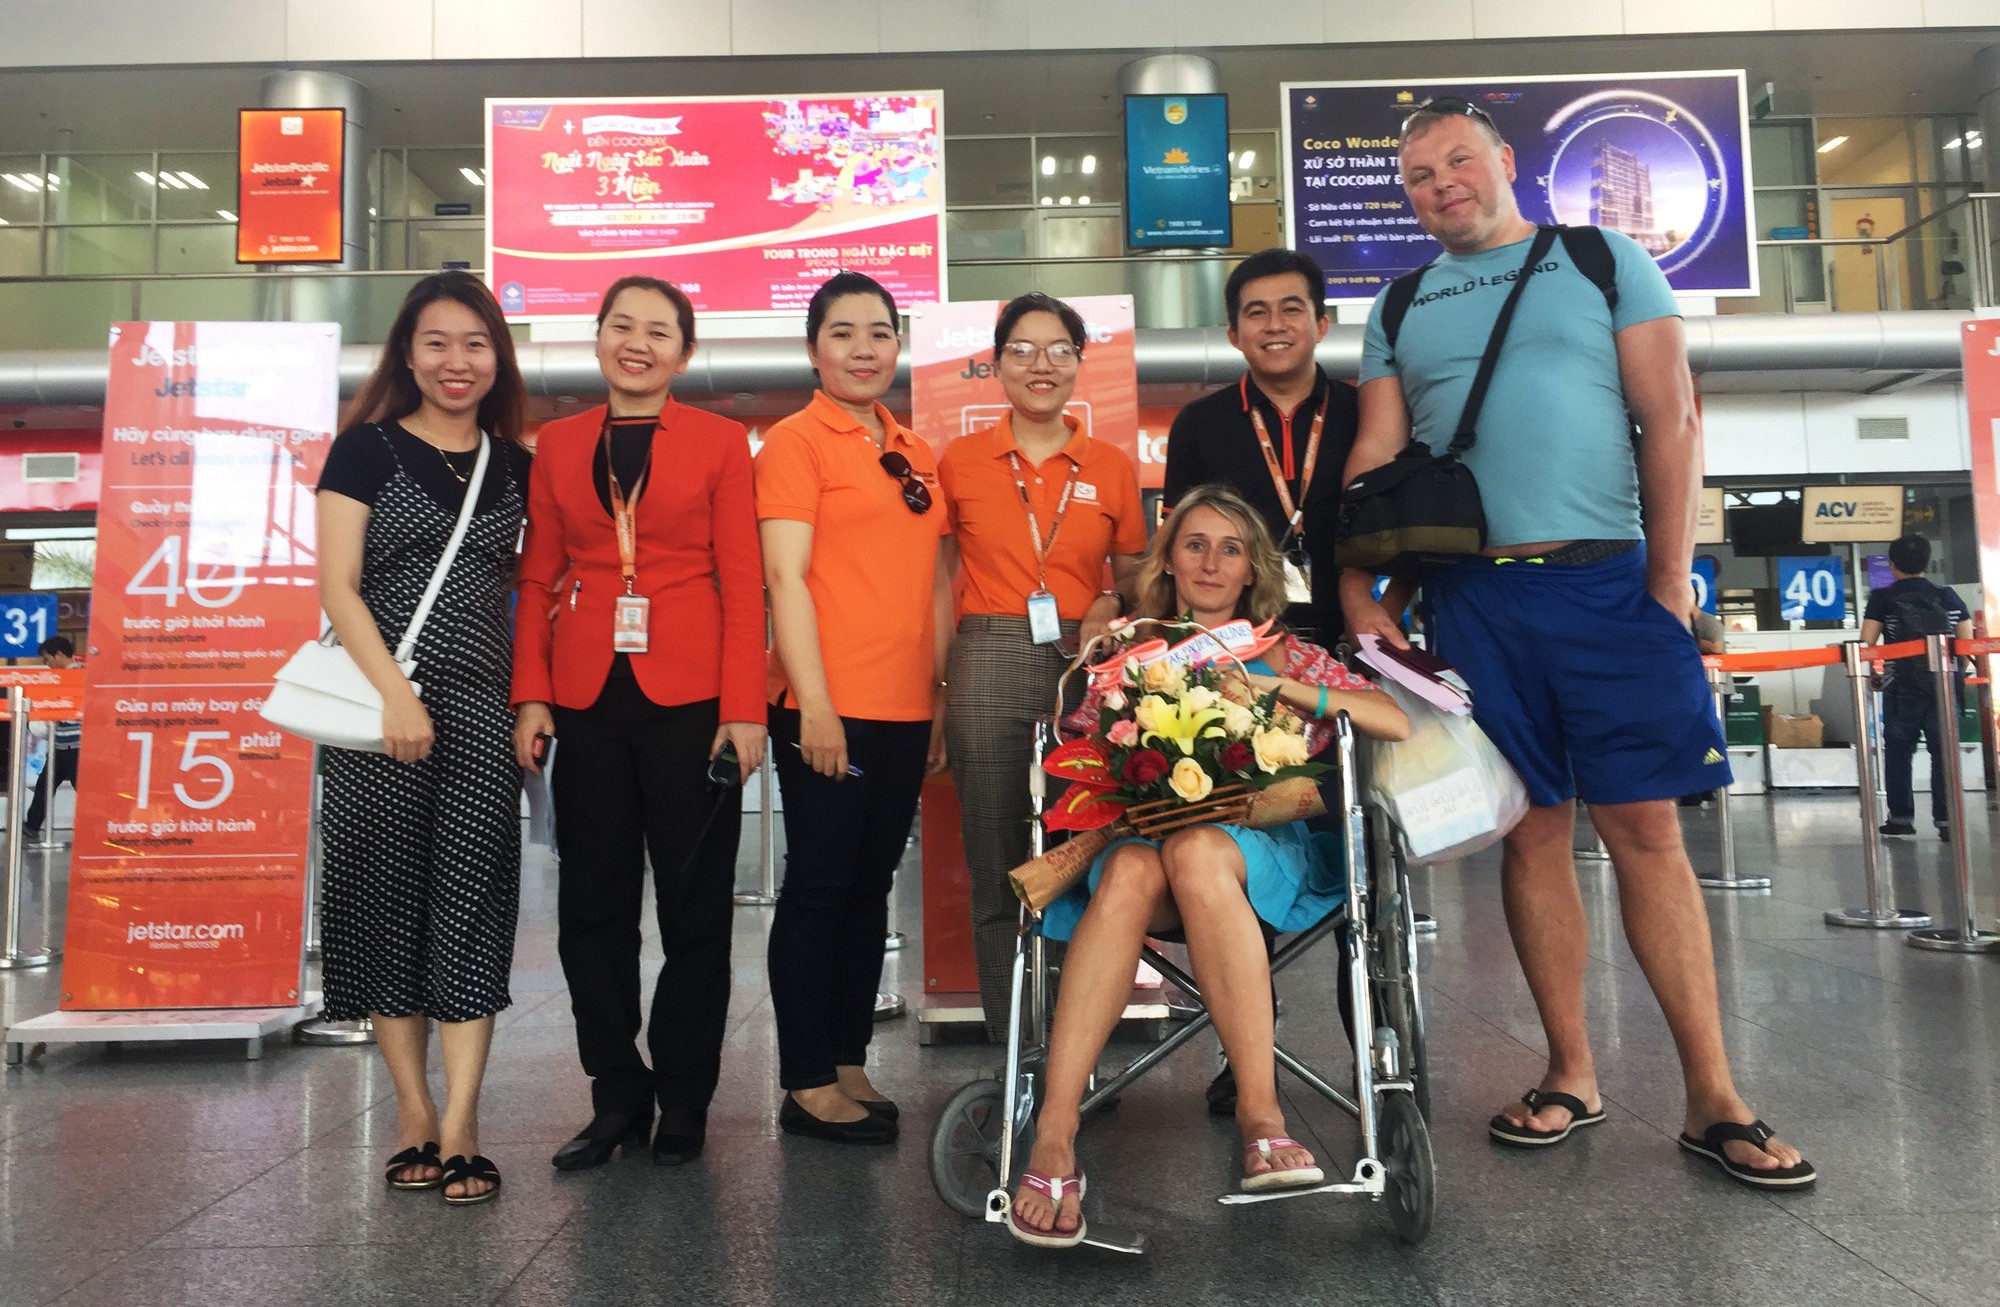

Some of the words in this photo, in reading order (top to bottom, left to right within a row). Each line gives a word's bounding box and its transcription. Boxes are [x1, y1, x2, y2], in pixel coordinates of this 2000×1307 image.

[1303, 138, 1341, 150] Coco
[1346, 136, 1400, 148] Wonde
[1303, 157, 1323, 169] XỨ
[1348, 155, 1385, 168] THẦN
[596, 176, 609, 196] 3
[1304, 176, 1326, 189] TẠI
[1329, 174, 1391, 187] COCOBAY
[1308, 219, 1328, 227] Cam
[763, 249, 794, 260] TOUR
[797, 248, 839, 259] TRONG
[841, 244, 876, 257] NGÀY
[909, 243, 933, 258] BIỆT
[1413, 281, 1476, 308] WORLD
[1479, 262, 1559, 287] LEGND
[131, 451, 166, 466] Let's
[1815, 502, 1857, 517] ACV
[1785, 570, 1836, 607] 40
[4, 607, 47, 646] 31
[152, 700, 168, 712] ra
[209, 698, 240, 714] bay
[239, 730, 282, 752] phút
[127, 731, 235, 810] 15
[217, 818, 256, 832] hành
[126, 921, 245, 944] jetstar.com
